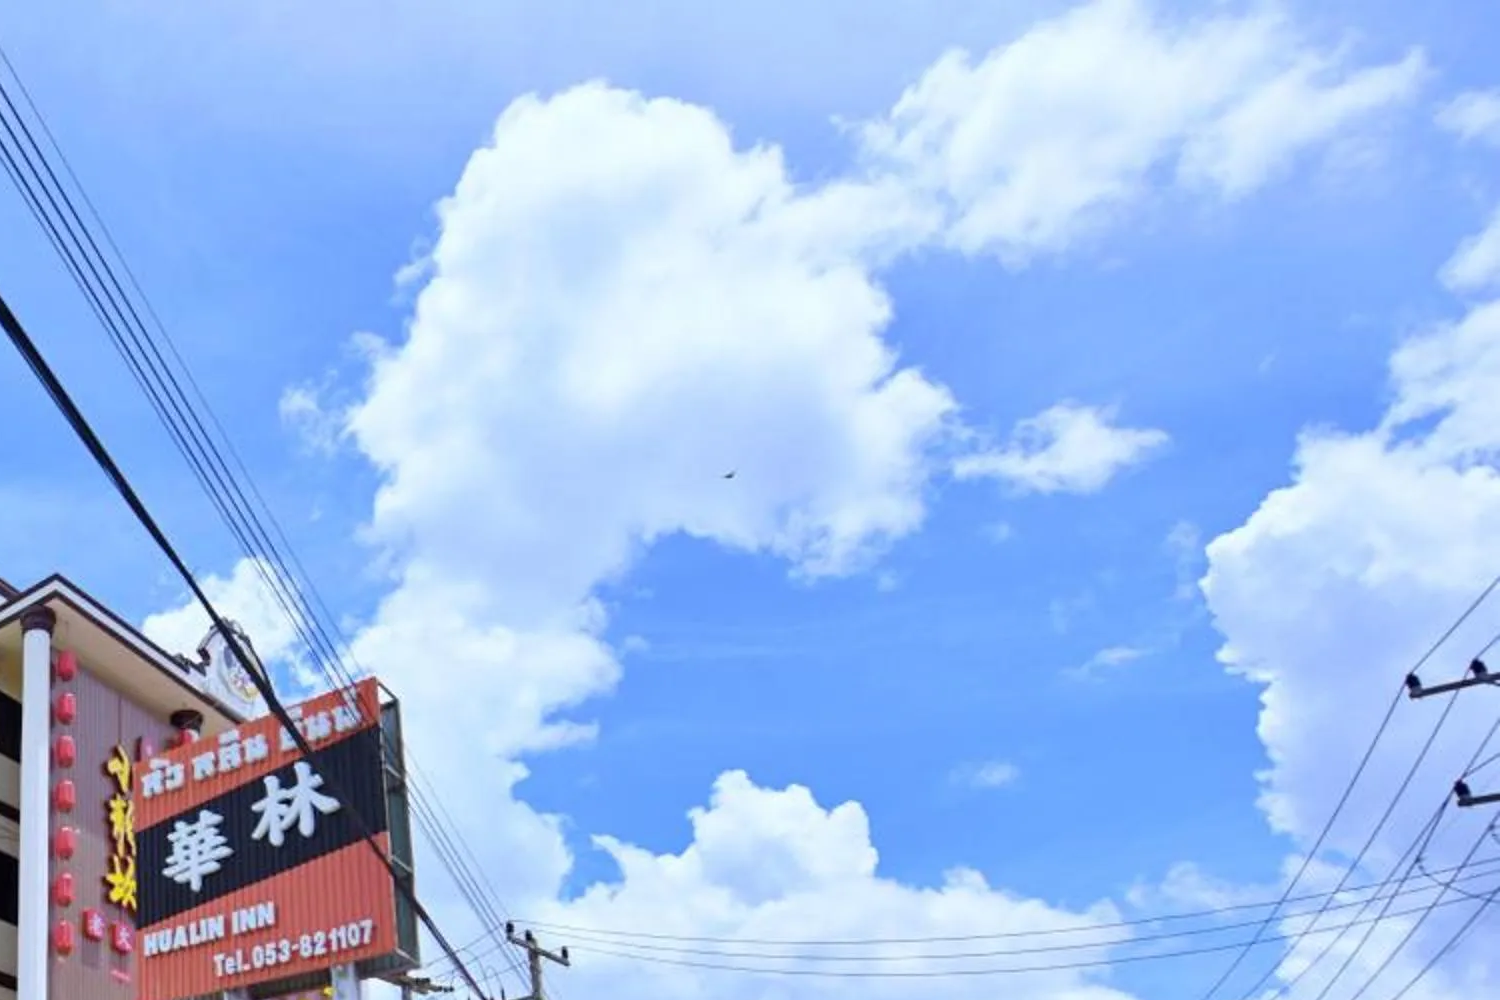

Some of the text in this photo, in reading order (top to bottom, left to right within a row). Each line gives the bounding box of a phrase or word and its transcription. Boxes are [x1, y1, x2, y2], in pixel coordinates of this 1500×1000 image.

[161, 760, 340, 892] 華林
[143, 901, 275, 957] HUALIN INN
